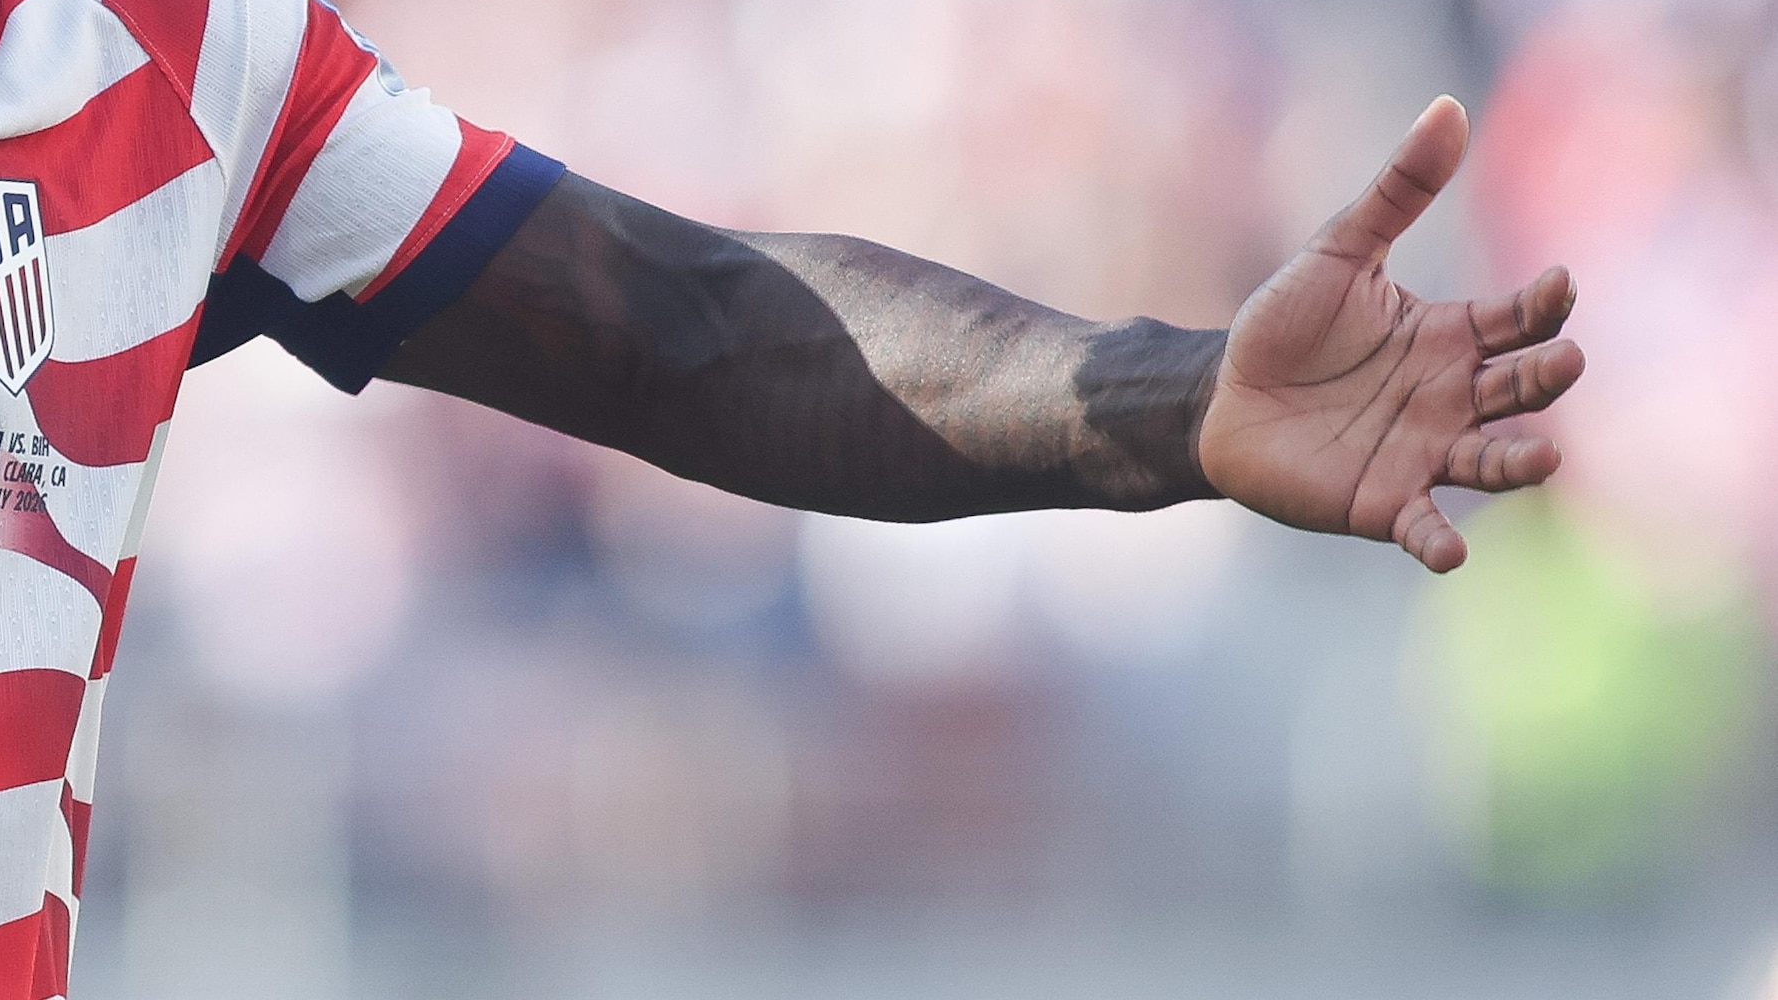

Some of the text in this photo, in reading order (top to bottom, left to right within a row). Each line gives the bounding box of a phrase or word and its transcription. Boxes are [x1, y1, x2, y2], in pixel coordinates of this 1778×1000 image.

[8, 432, 26, 454] VS.
[3, 461, 45, 488] CLARA,
[51, 466, 66, 487] CA
